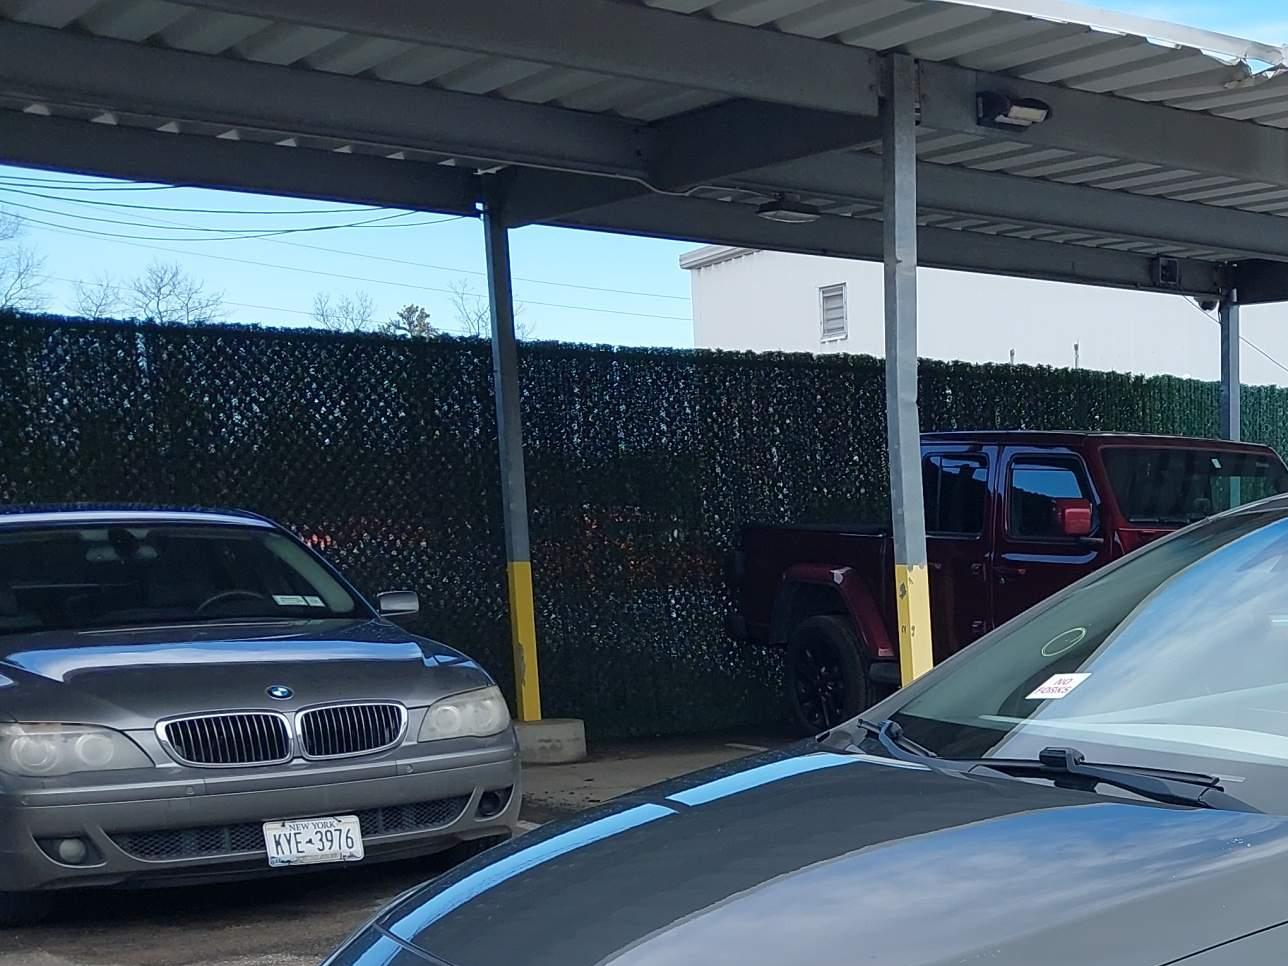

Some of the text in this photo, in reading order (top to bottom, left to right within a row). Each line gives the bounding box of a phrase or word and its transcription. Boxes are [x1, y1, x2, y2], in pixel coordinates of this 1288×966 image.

[312, 821, 336, 829] YORK
[273, 828, 354, 855] KYE 3976
